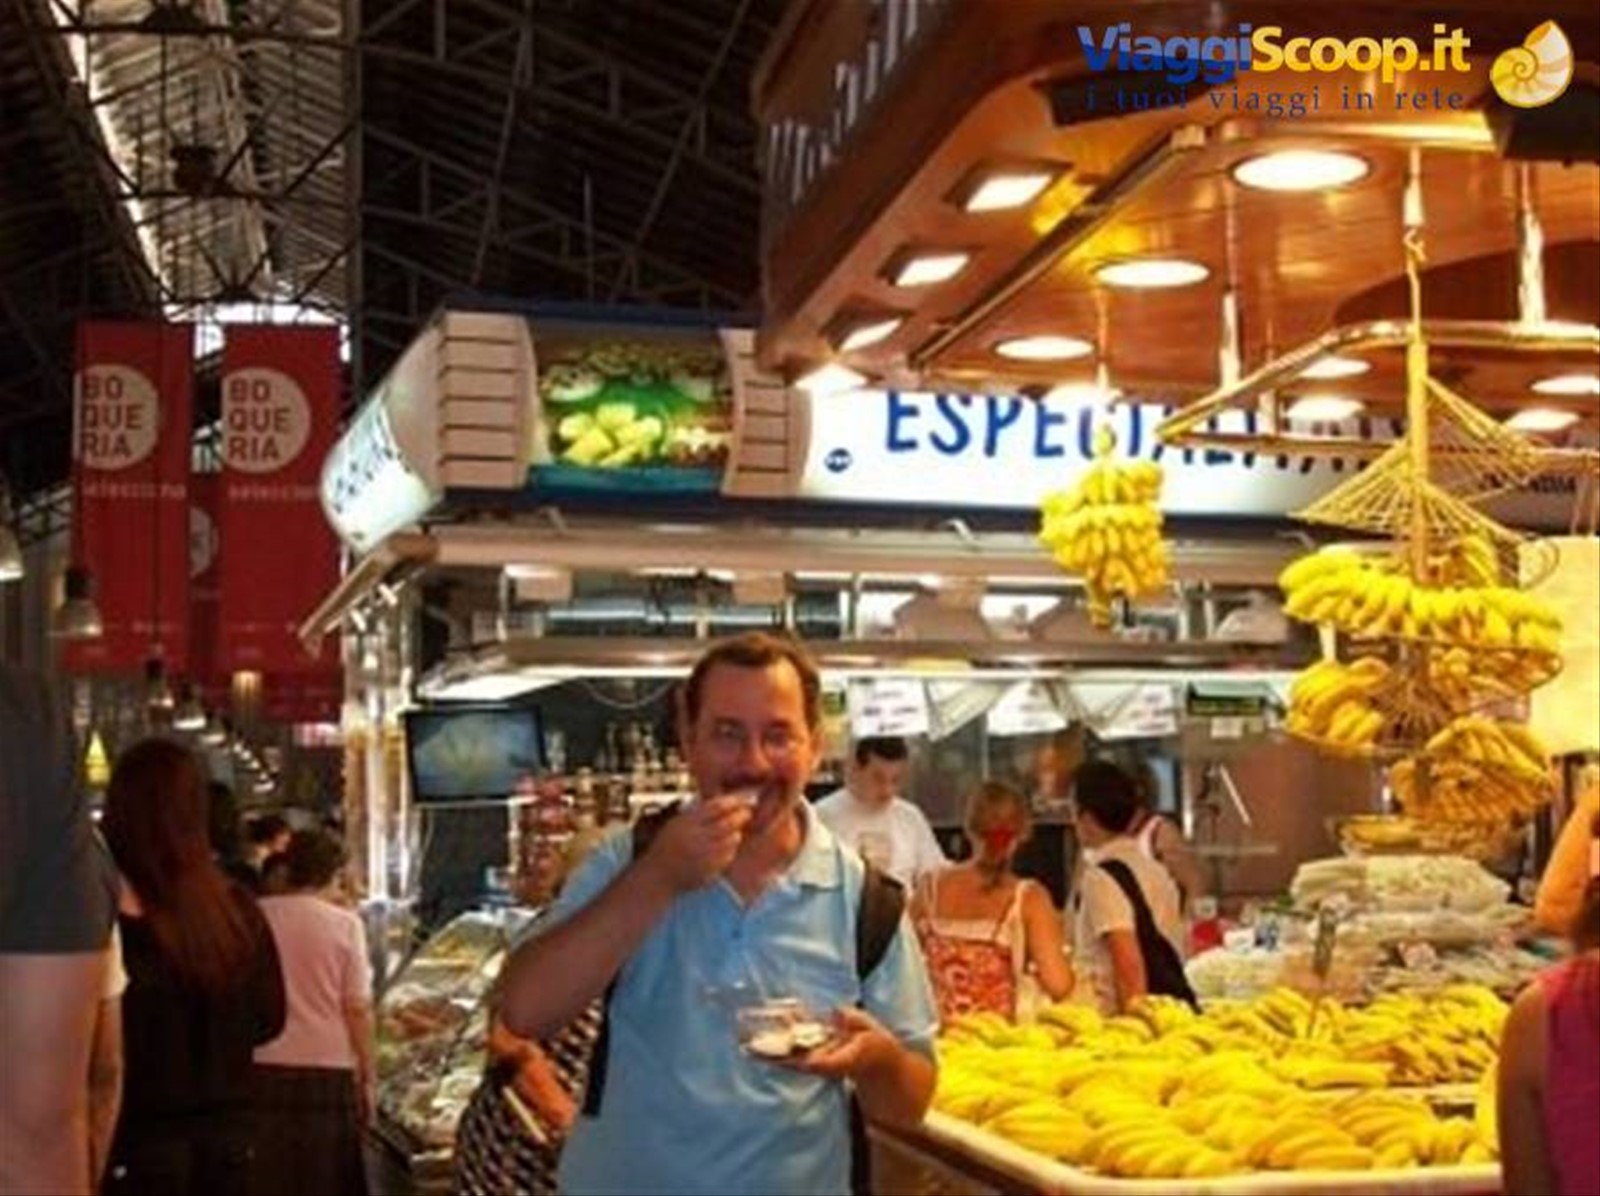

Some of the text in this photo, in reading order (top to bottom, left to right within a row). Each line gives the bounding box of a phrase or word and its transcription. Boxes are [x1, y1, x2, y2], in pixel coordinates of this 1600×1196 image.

[82, 375, 123, 400] BO
[229, 379, 271, 401] BO
[81, 404, 143, 430] QUE
[228, 407, 291, 433] QUE
[83, 432, 131, 459] RIA
[229, 436, 280, 461] RIA
